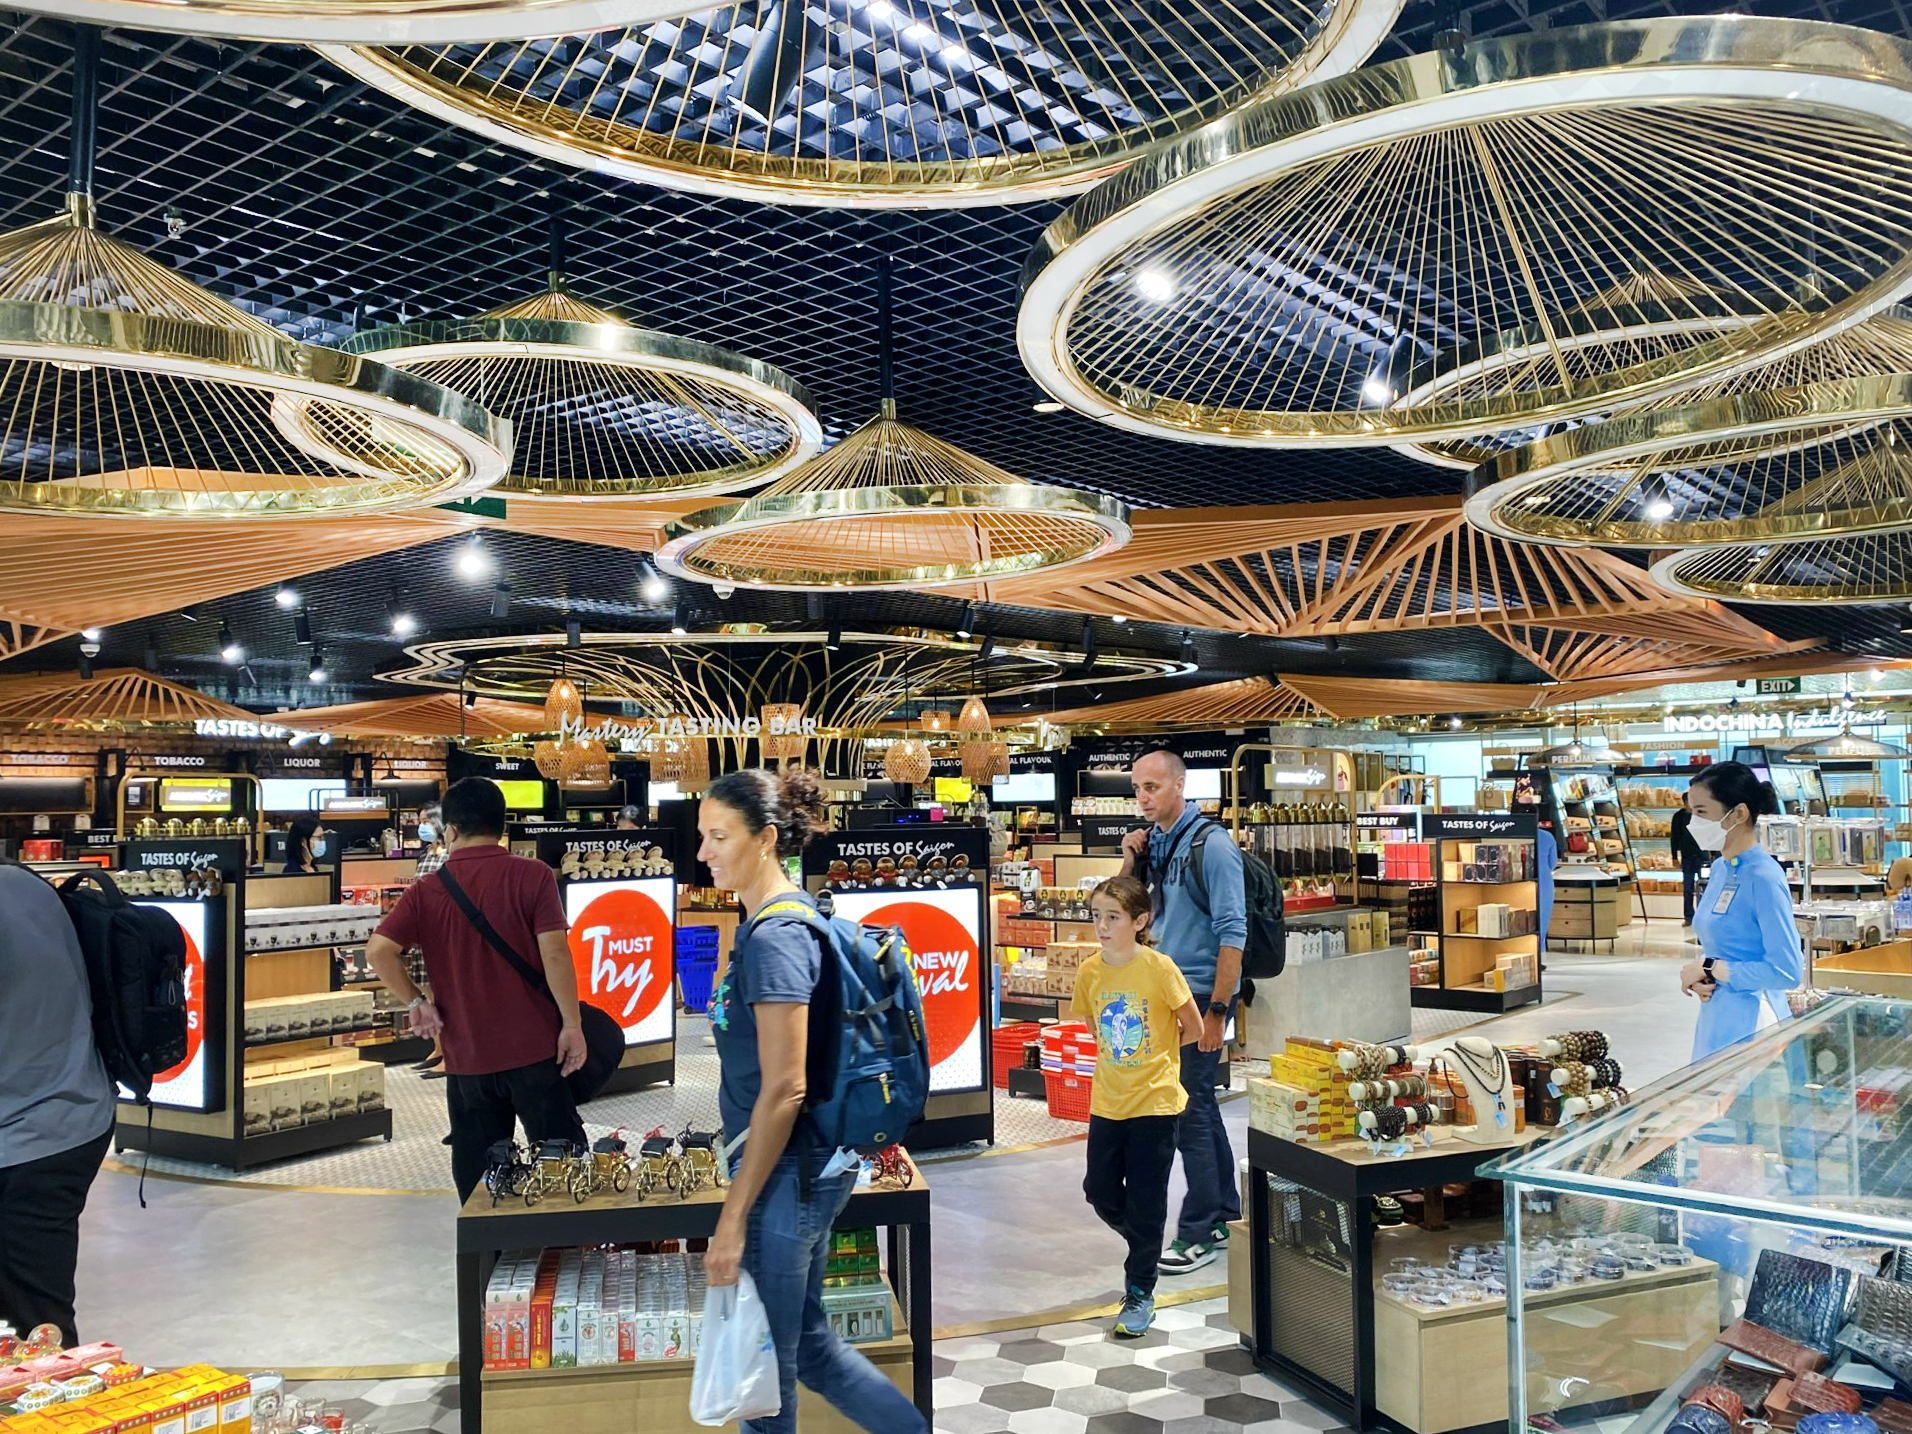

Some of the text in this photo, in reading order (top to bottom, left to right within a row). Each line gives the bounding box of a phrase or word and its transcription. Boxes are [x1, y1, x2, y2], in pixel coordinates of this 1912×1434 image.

[1761, 680, 1788, 692] EXIT
[1664, 706, 1887, 732] INDOCHINA Indulgence
[194, 719, 259, 737] TASTES
[559, 710, 817, 744] Mastery TASTING BAR
[1640, 742, 1686, 750] FASHION
[1088, 753, 1130, 762] AUTHENTIC
[1183, 750, 1227, 758] AUTHENTIC
[154, 756, 205, 766] TOBACCO
[284, 758, 321, 768] LIQUOR
[1019, 756, 1052, 764] FLAVOUR
[495, 763, 519, 771] SWEET
[1357, 817, 1399, 826] BEST BUY
[1442, 820, 1516, 832] TASTES OF Saigon
[1098, 827, 1119, 836] TASTES
[88, 835, 110, 843] BEST
[565, 841, 605, 853] TASTES
[606, 841, 622, 852] OF
[837, 840, 955, 859] TASTES OF Saigon
[141, 851, 218, 870] TASTES OF Saigon
[608, 936, 653, 955] MUST
[912, 951, 959, 971] NEW
